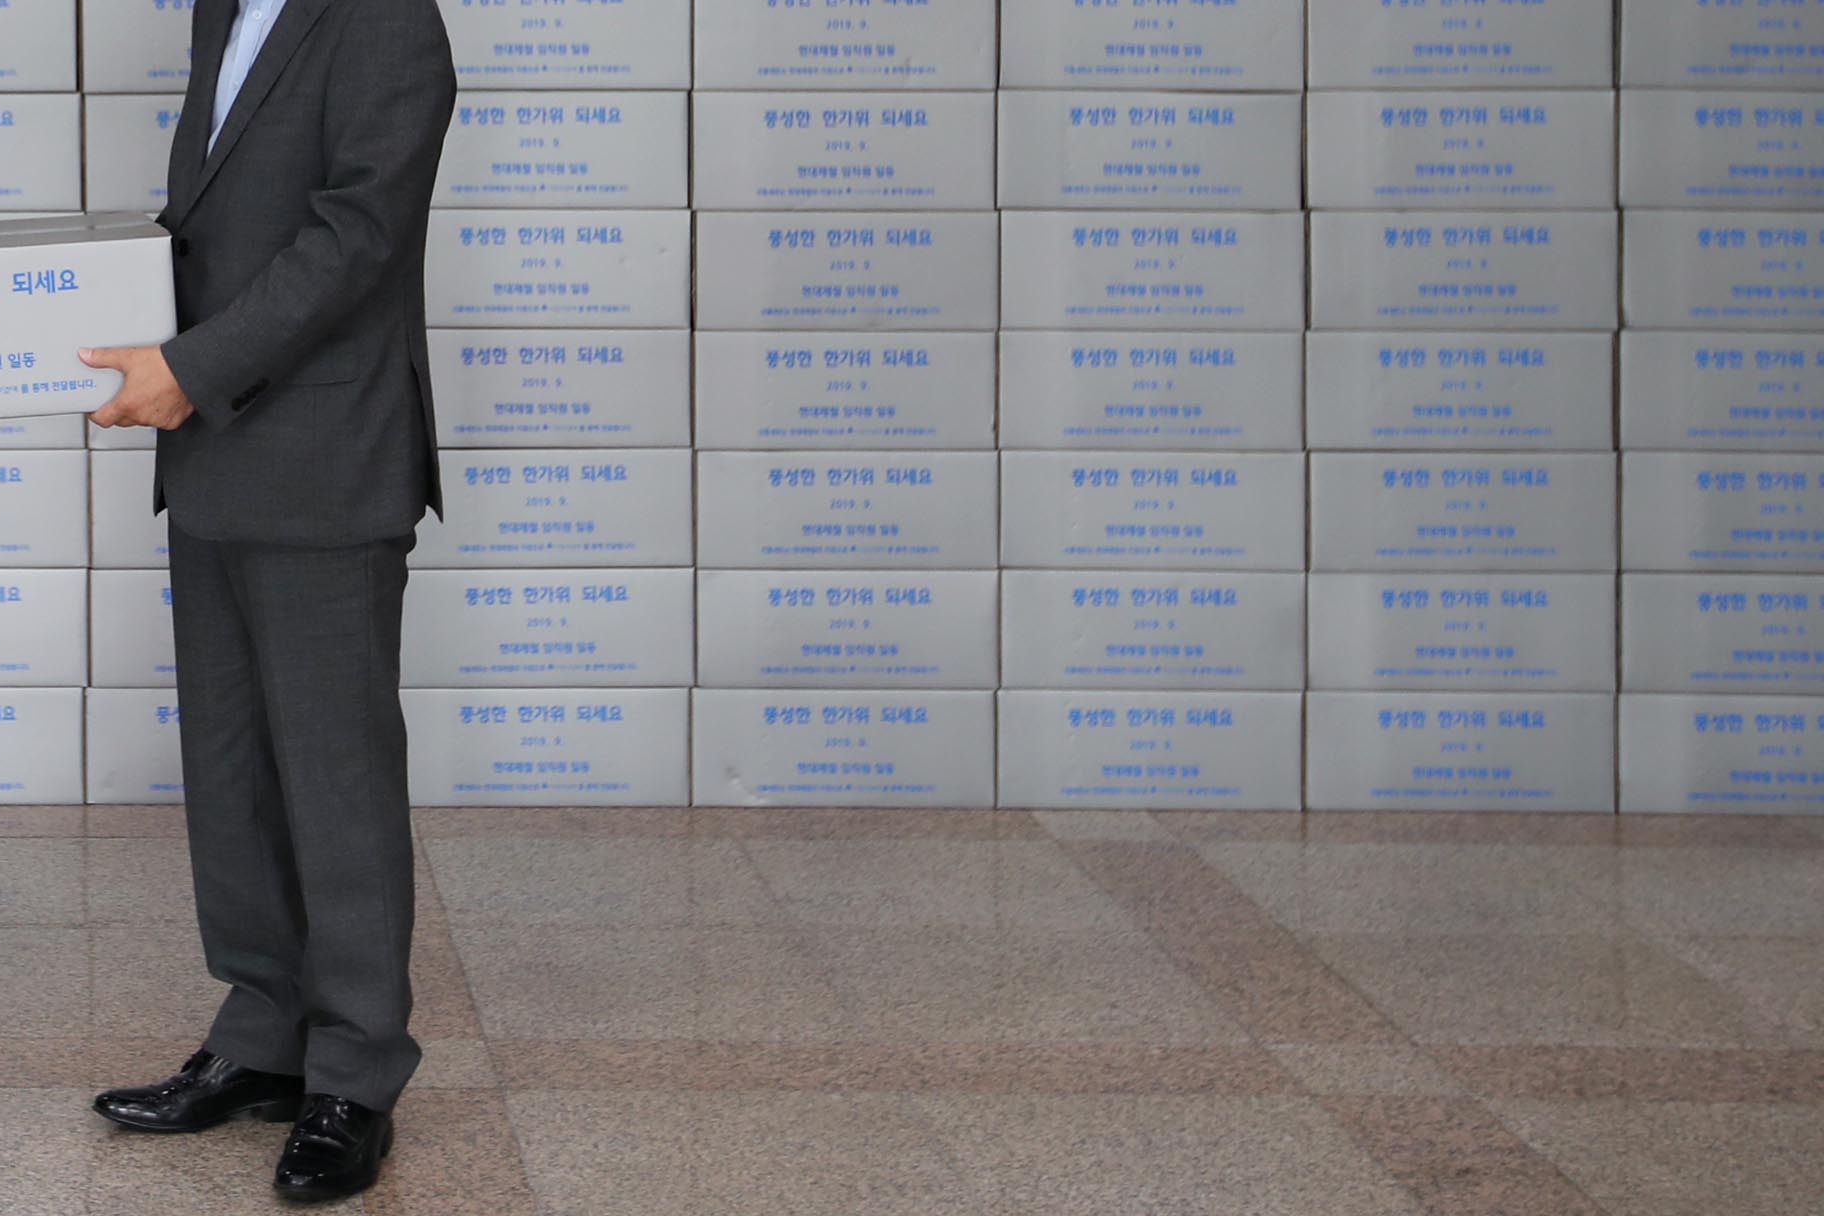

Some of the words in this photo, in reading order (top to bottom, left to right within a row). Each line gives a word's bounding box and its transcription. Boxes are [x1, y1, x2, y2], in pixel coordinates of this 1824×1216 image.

[460, 228, 506, 246] 풍성한
[518, 227, 565, 245] 한가위
[576, 227, 623, 244] 되세요
[768, 230, 816, 248] 풍성한
[827, 229, 874, 247] 한가위
[887, 229, 932, 246] 되세요
[12, 269, 79, 295] 되세요
[8, 352, 36, 368] 일동
[461, 347, 507, 366] 풍성한
[519, 347, 566, 364] 한가위
[577, 346, 623, 364] 되세요
[465, 467, 512, 485] 풍성한
[523, 466, 569, 483] 한가위
[581, 465, 627, 481] 되세요
[769, 469, 816, 487] 풍성한
[827, 468, 874, 485] 한가위
[887, 468, 932, 485] 되세요
